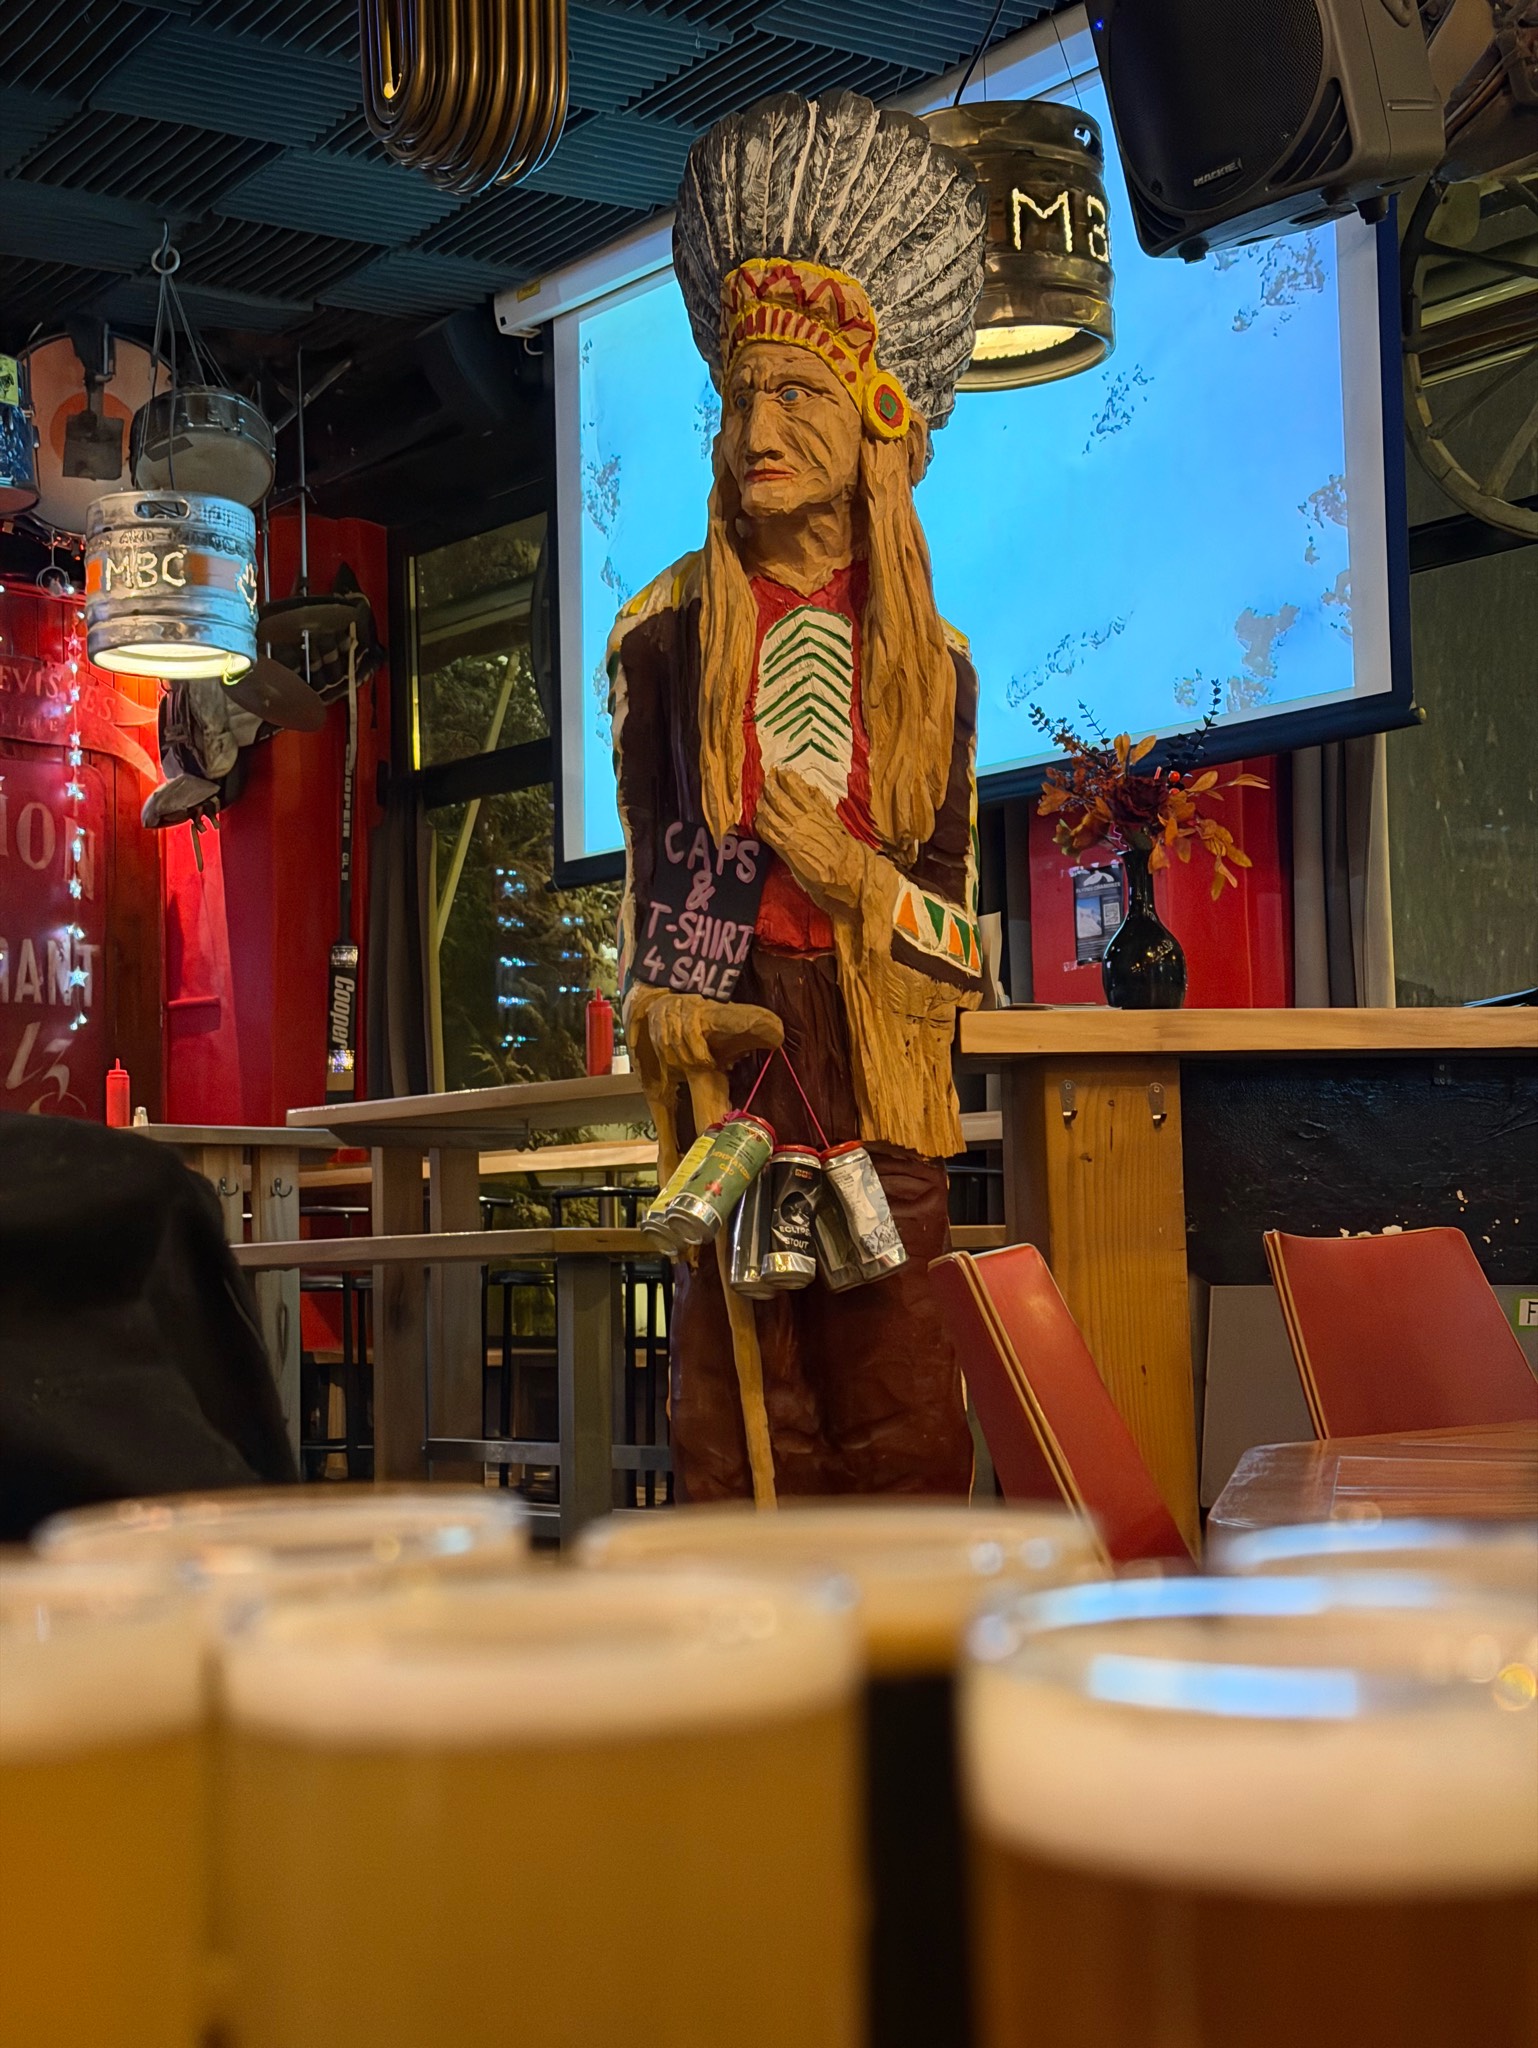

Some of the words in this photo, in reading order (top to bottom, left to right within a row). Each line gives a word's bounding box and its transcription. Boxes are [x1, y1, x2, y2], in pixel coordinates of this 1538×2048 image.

[105, 549, 187, 592] MBC
[664, 821, 760, 884] CAPS
[685, 869, 716, 911] &
[647, 901, 755, 965] T-SHIRT
[643, 945, 666, 982] 4
[669, 955, 741, 1001] SALE
[331, 975, 355, 1050] Cooper
[784, 1237, 809, 1249] STOUT
